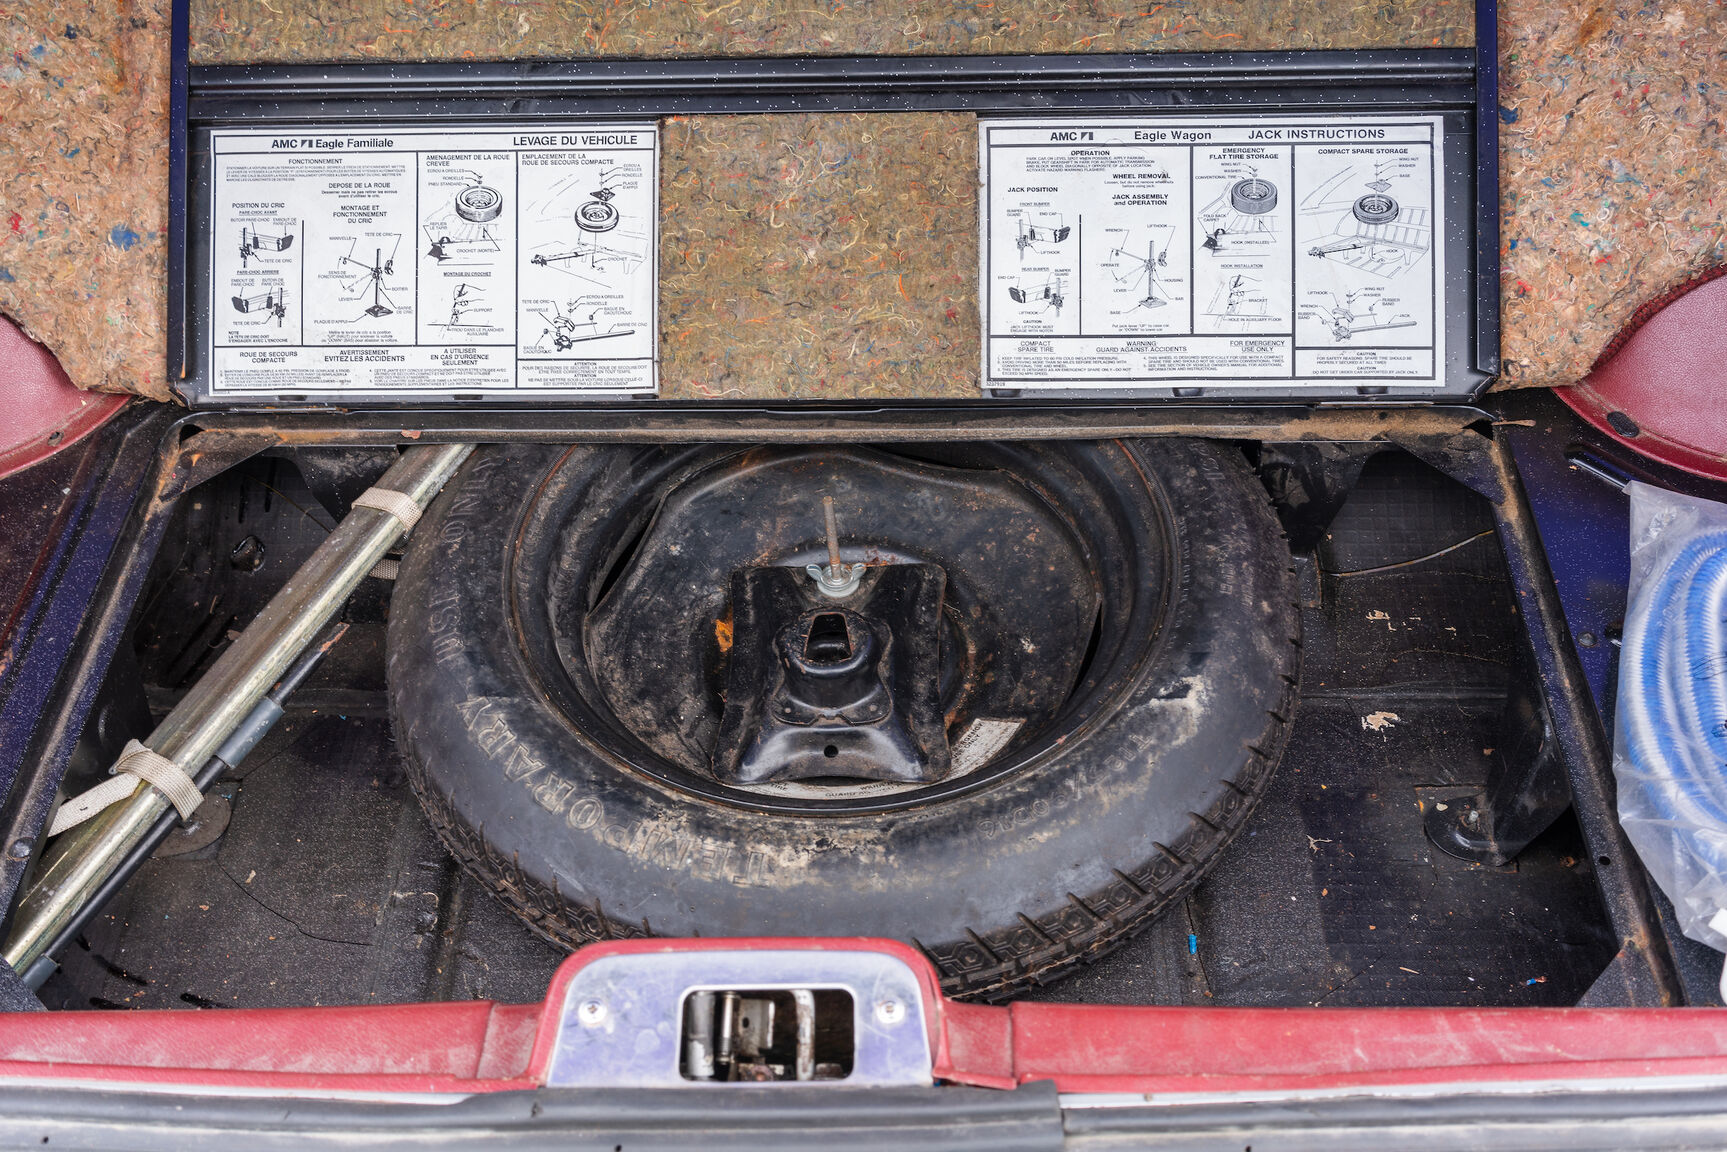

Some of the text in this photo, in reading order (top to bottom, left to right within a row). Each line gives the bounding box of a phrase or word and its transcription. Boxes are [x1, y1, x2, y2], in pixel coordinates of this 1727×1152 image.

[271, 135, 638, 150] AMC Eagle Familiale LEVAGE DU VEHICULE
[1050, 129, 1385, 142] AMC Eagle Wagon JACK INSTRUCTIONS
[521, 158, 539, 166] ROUE
[540, 158, 549, 166] DE
[550, 158, 580, 166] SECOURS
[440, 353, 453, 361] CAS
[428, 584, 466, 666] USE
[455, 695, 771, 889] TEMPORARY
